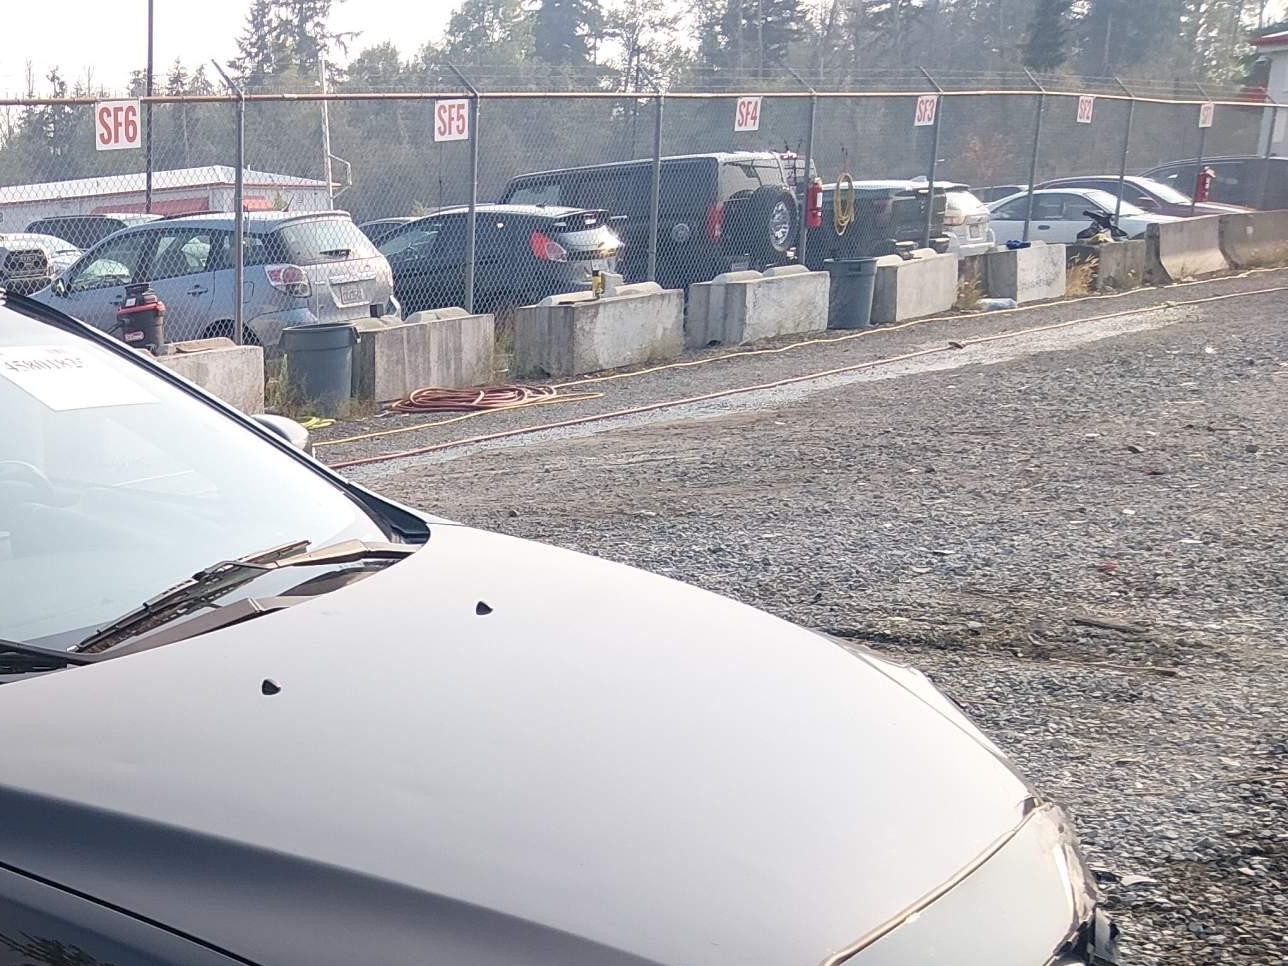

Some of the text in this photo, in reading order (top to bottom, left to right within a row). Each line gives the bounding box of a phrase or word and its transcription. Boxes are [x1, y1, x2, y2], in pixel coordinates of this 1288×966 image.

[98, 105, 138, 145] SF6
[437, 103, 466, 136] SF5
[737, 100, 759, 128] SF4
[917, 99, 935, 122] SF3
